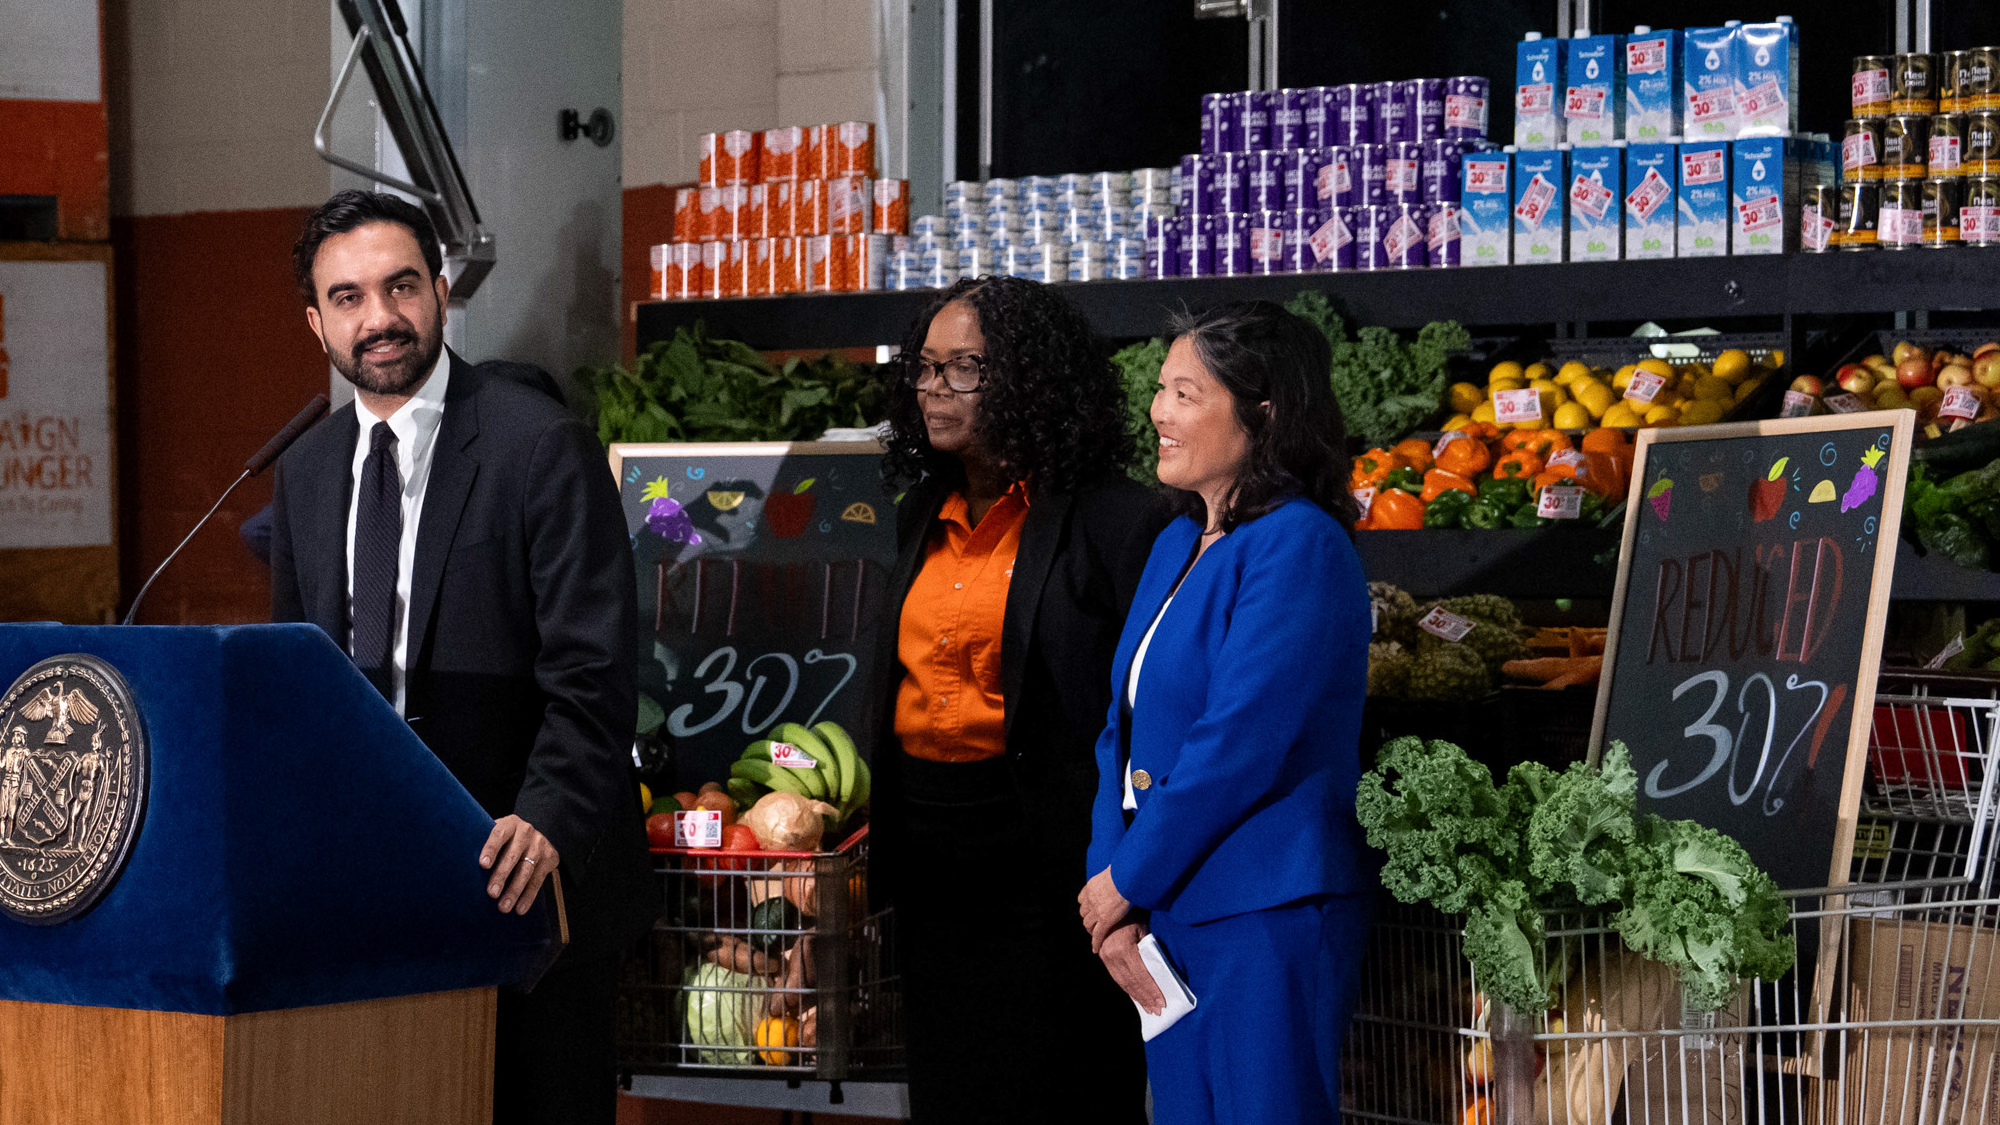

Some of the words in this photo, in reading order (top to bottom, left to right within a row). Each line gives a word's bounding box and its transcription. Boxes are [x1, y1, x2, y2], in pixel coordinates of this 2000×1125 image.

[1646, 537, 1843, 665] REDUCED
[23, 857, 56, 873] 1625
[47, 863, 82, 896] NOVI
[83, 790, 117, 865] EBORACI
[1928, 1009, 1940, 1099] VTABLES
